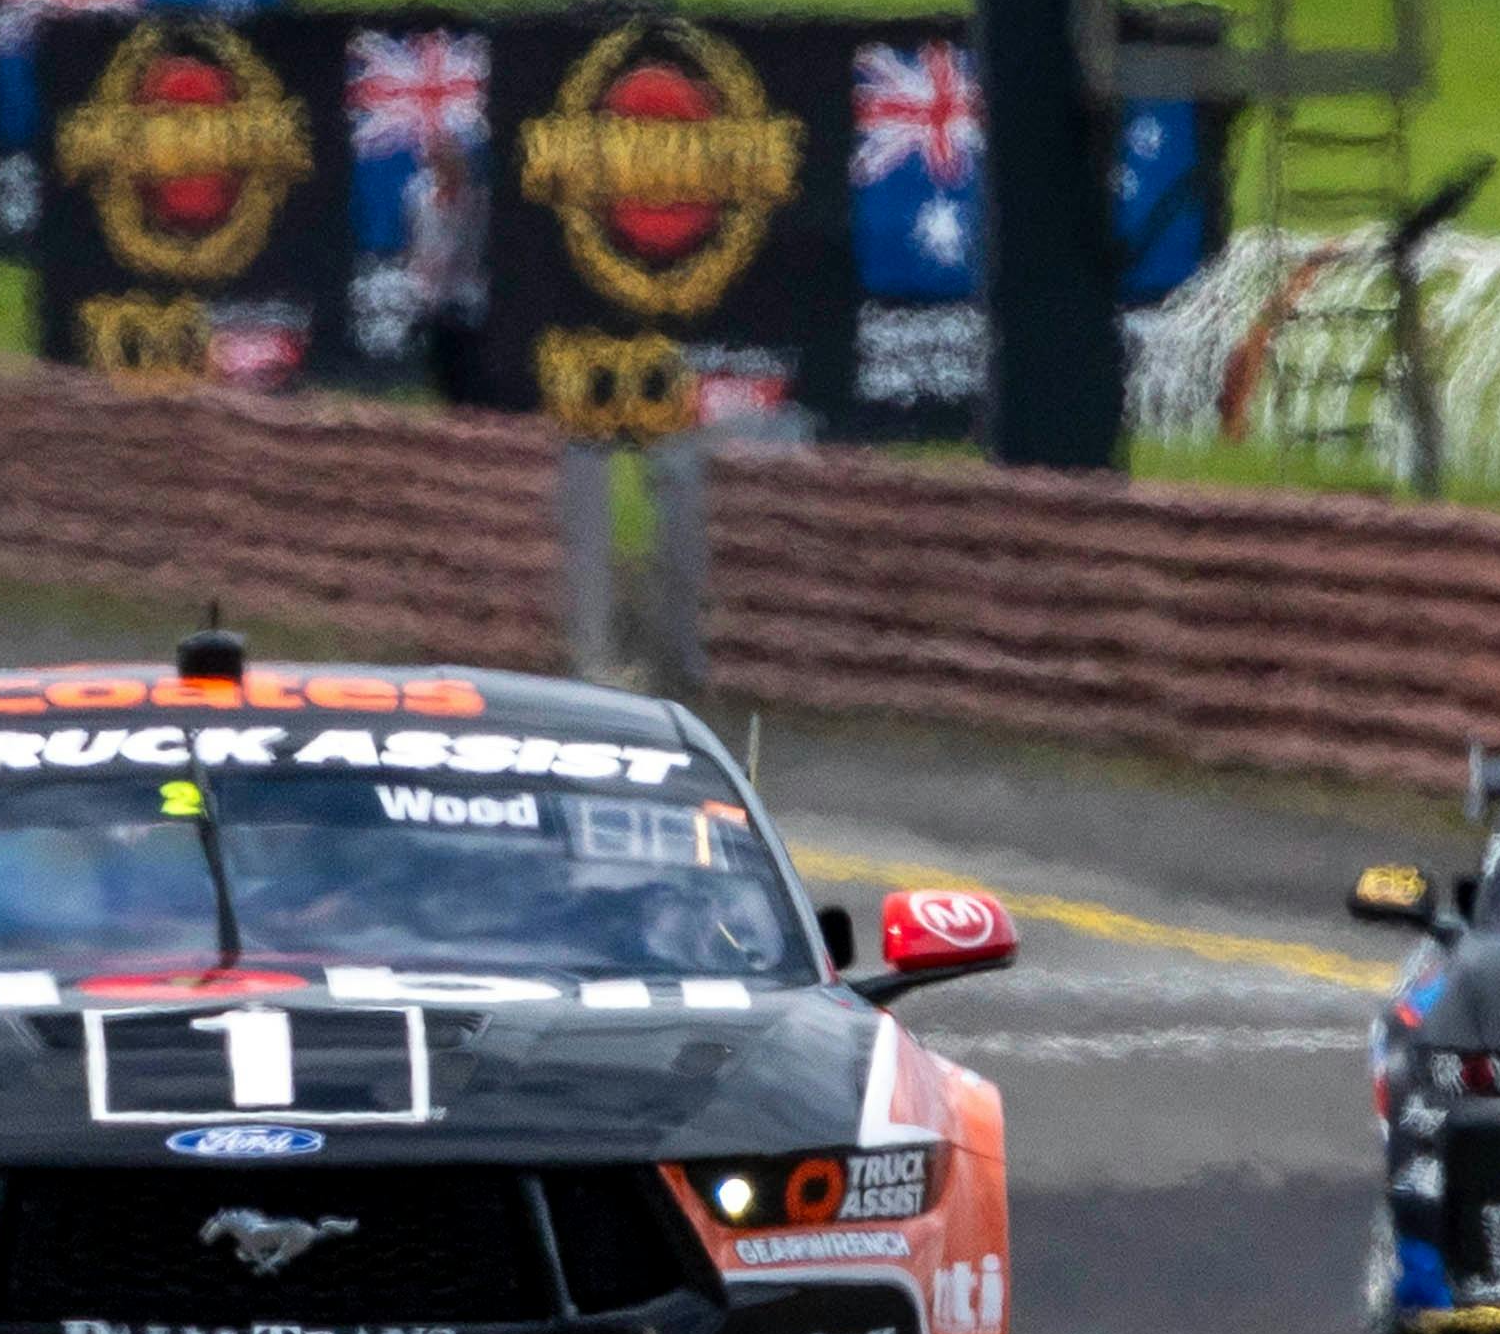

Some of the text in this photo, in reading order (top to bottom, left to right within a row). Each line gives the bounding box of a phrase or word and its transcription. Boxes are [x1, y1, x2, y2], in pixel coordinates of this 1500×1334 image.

[294, 729, 692, 785] ASSIST
[159, 780, 203, 817] 2
[374, 784, 539, 828] Wood
[190, 1007, 294, 1106] 1
[847, 1150, 927, 1186] TRUCK
[840, 1182, 927, 1219] ASSIST
